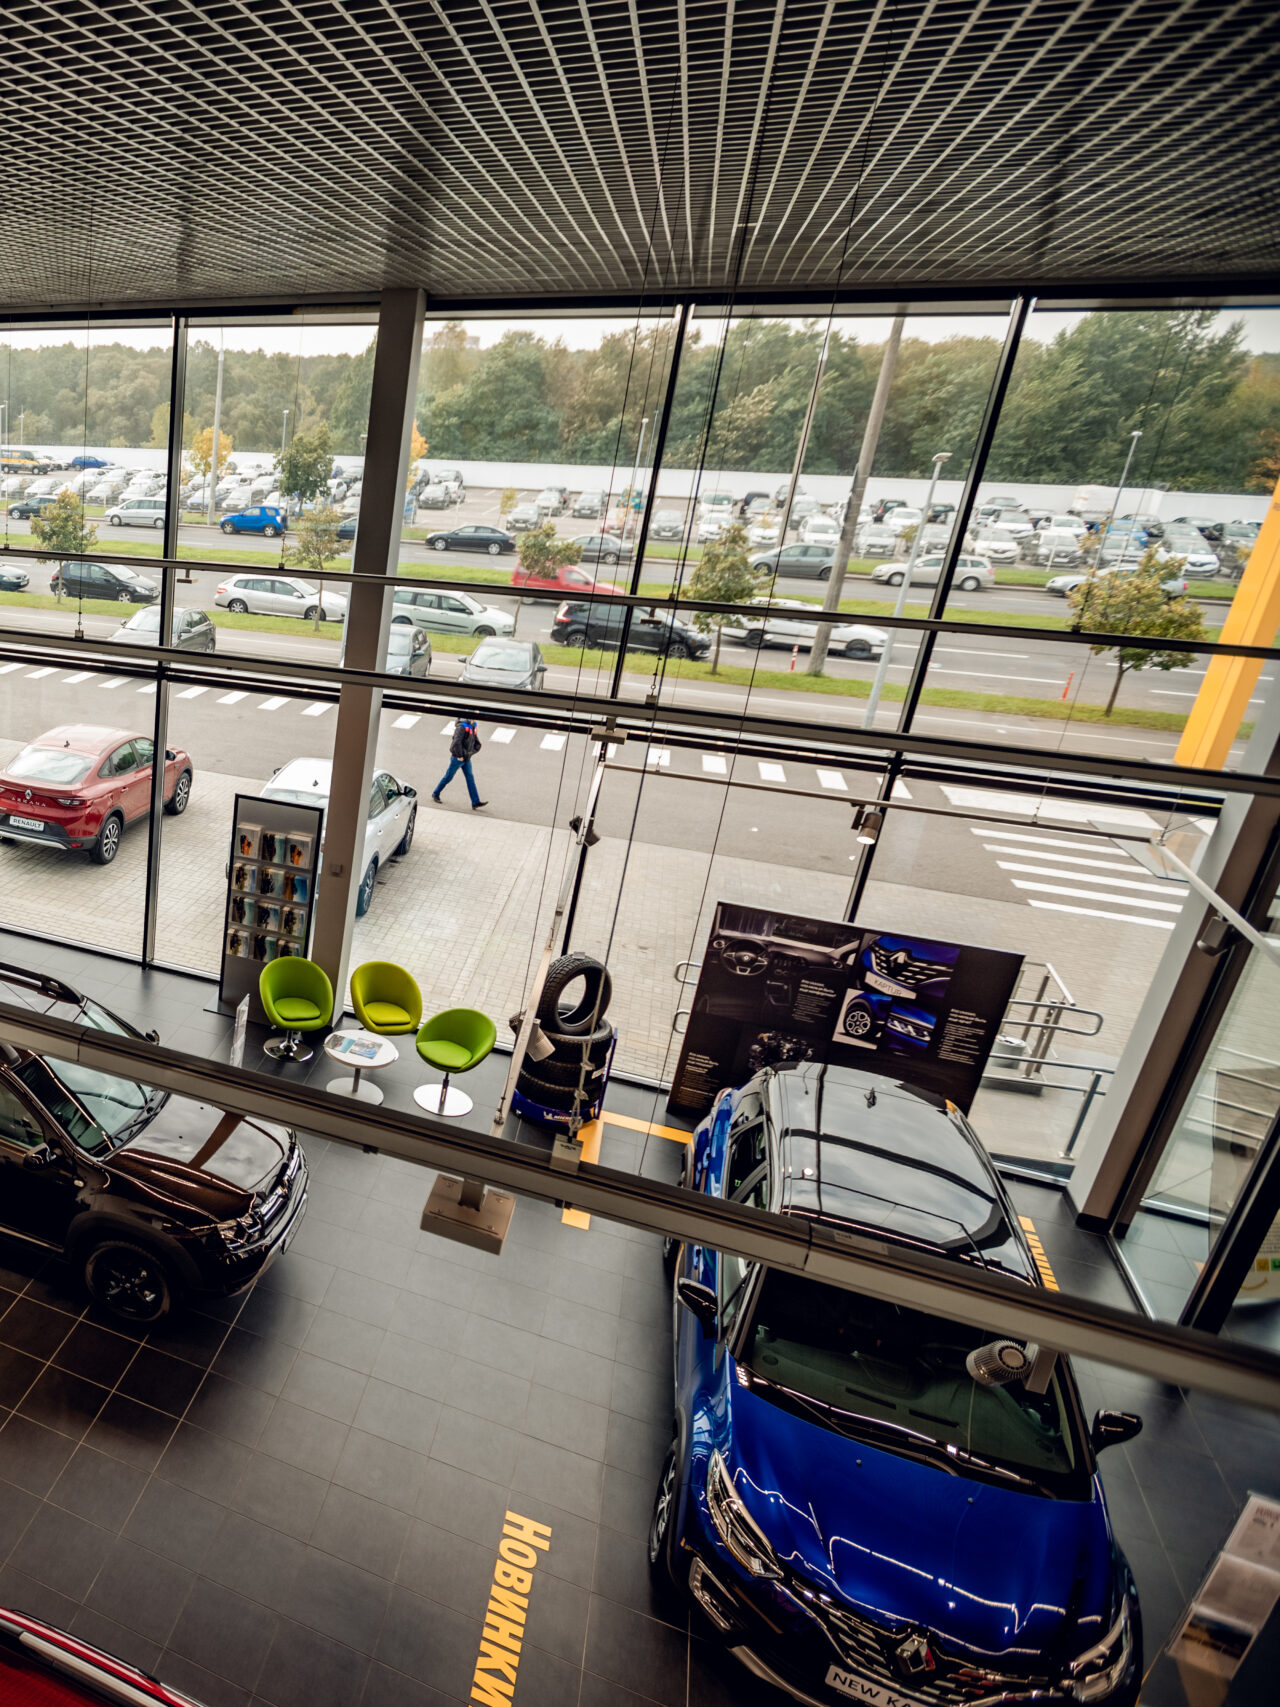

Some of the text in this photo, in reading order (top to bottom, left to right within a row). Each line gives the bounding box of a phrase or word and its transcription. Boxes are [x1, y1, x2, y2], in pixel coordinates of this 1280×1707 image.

[13, 818, 42, 828] RENAULT
[470, 1510, 552, 1707] НОВИНКИ
[833, 1672, 880, 1698] NEW
